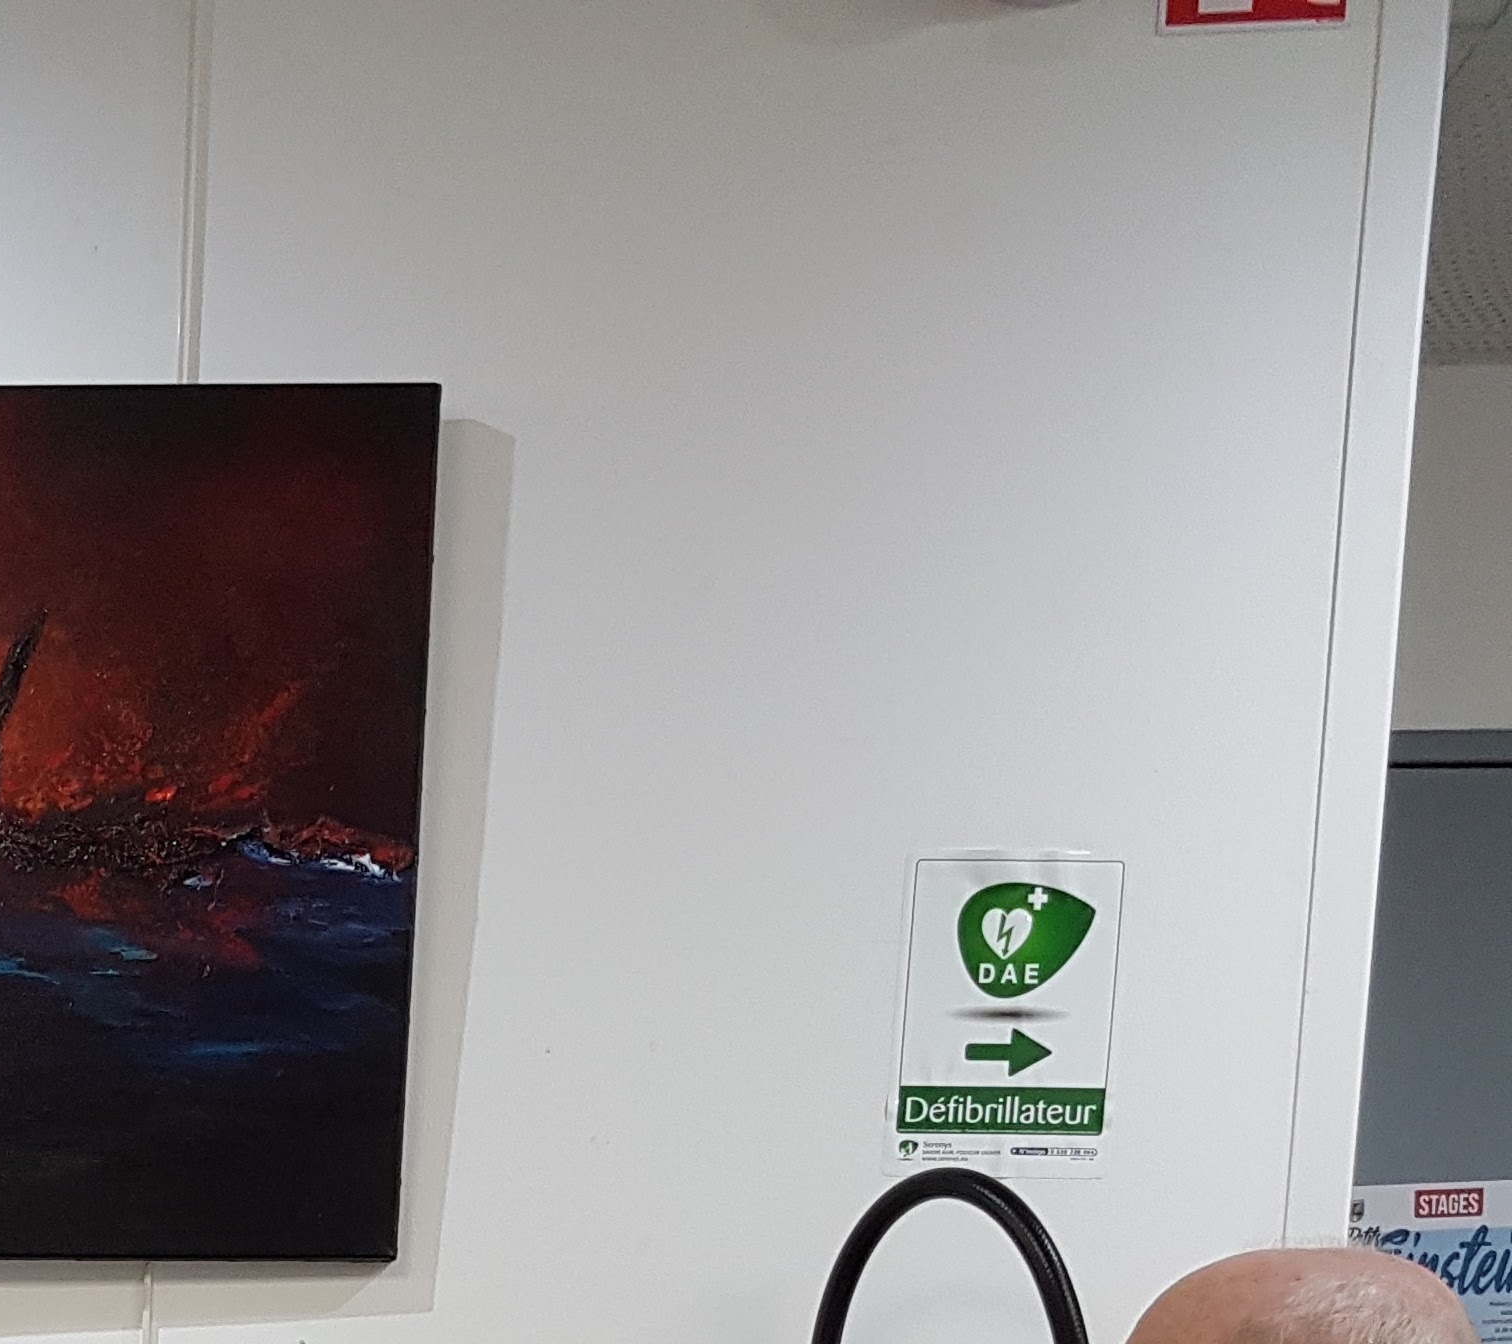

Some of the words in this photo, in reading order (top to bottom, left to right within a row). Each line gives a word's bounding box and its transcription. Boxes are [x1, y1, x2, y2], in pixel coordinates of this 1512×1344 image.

[978, 963, 1040, 984] DAE
[904, 1095, 1097, 1125] Défibrillateur
[1418, 1193, 1480, 1216] STAGES
